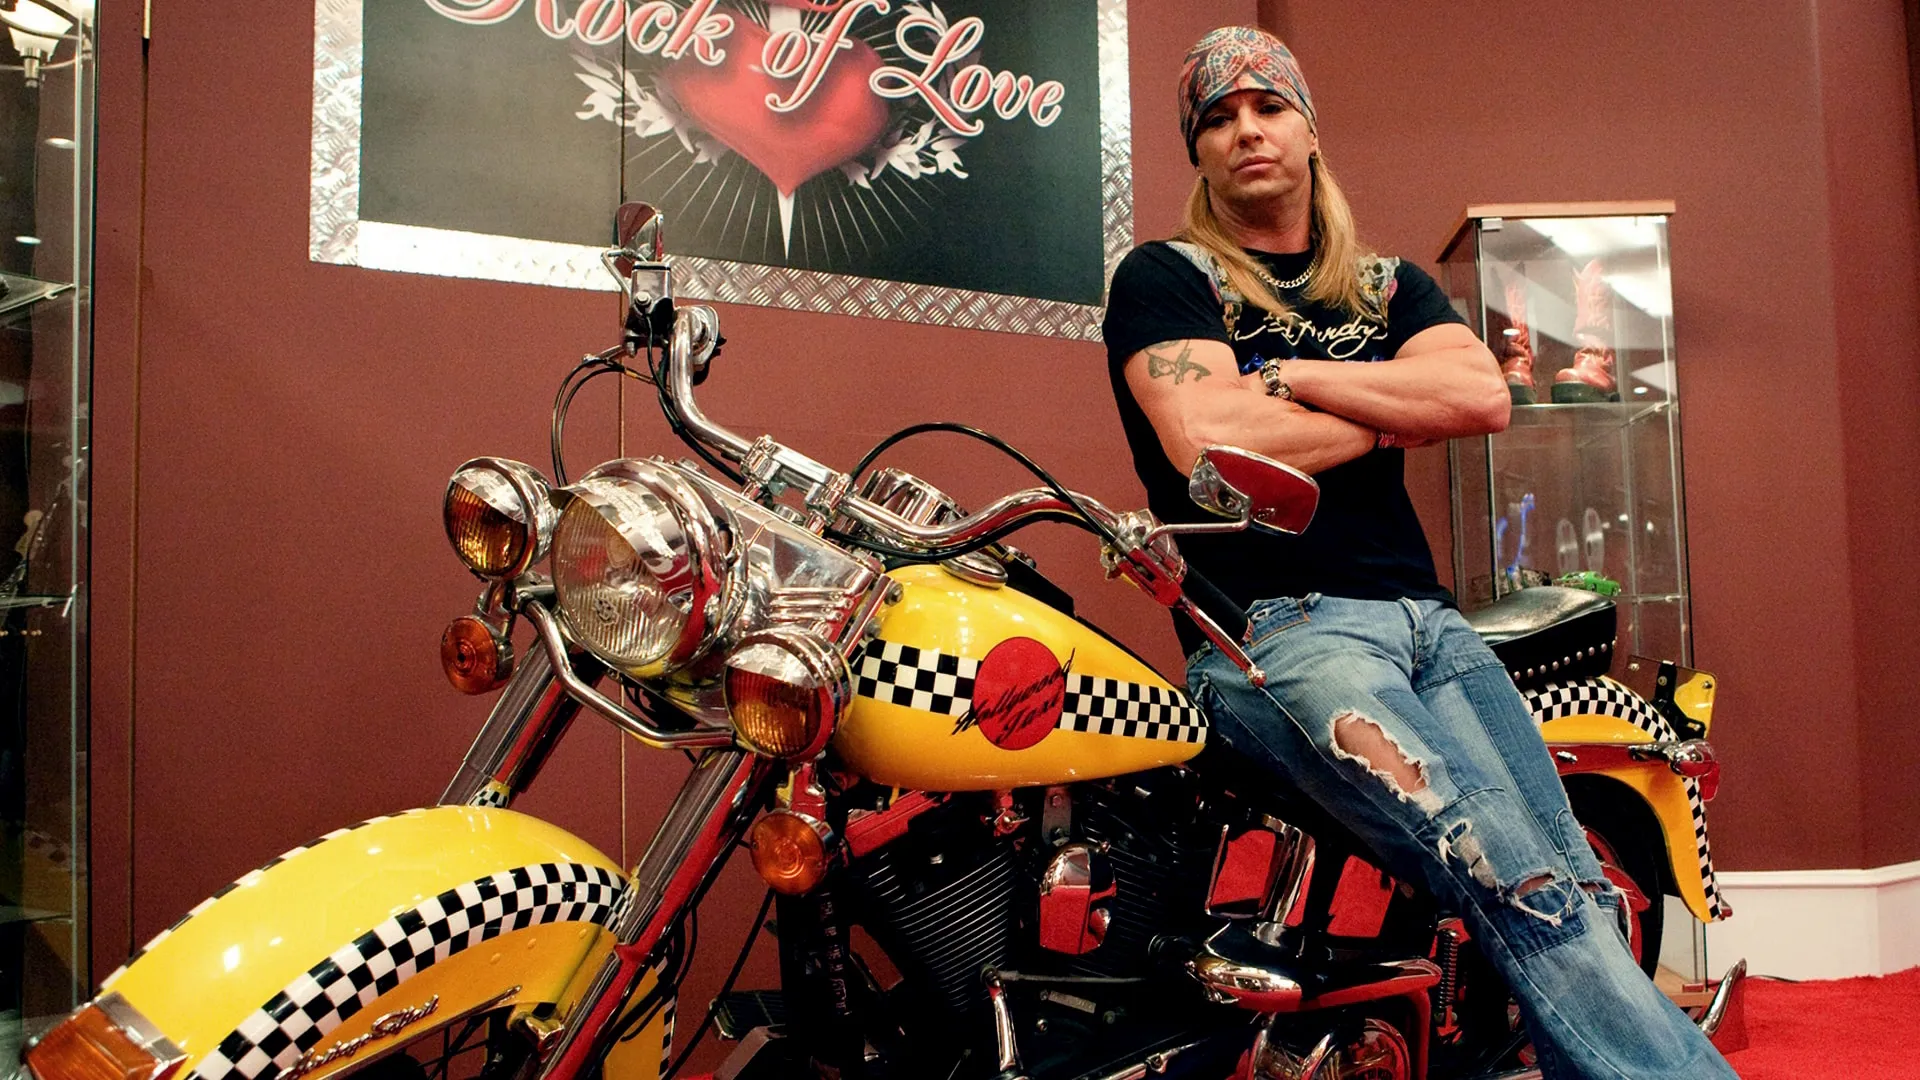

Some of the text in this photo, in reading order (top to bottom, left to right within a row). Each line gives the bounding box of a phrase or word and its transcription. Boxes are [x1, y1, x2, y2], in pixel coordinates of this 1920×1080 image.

[761, 0, 891, 112] of
[869, 16, 1065, 137] Love
[951, 647, 1076, 736] Hollywood
